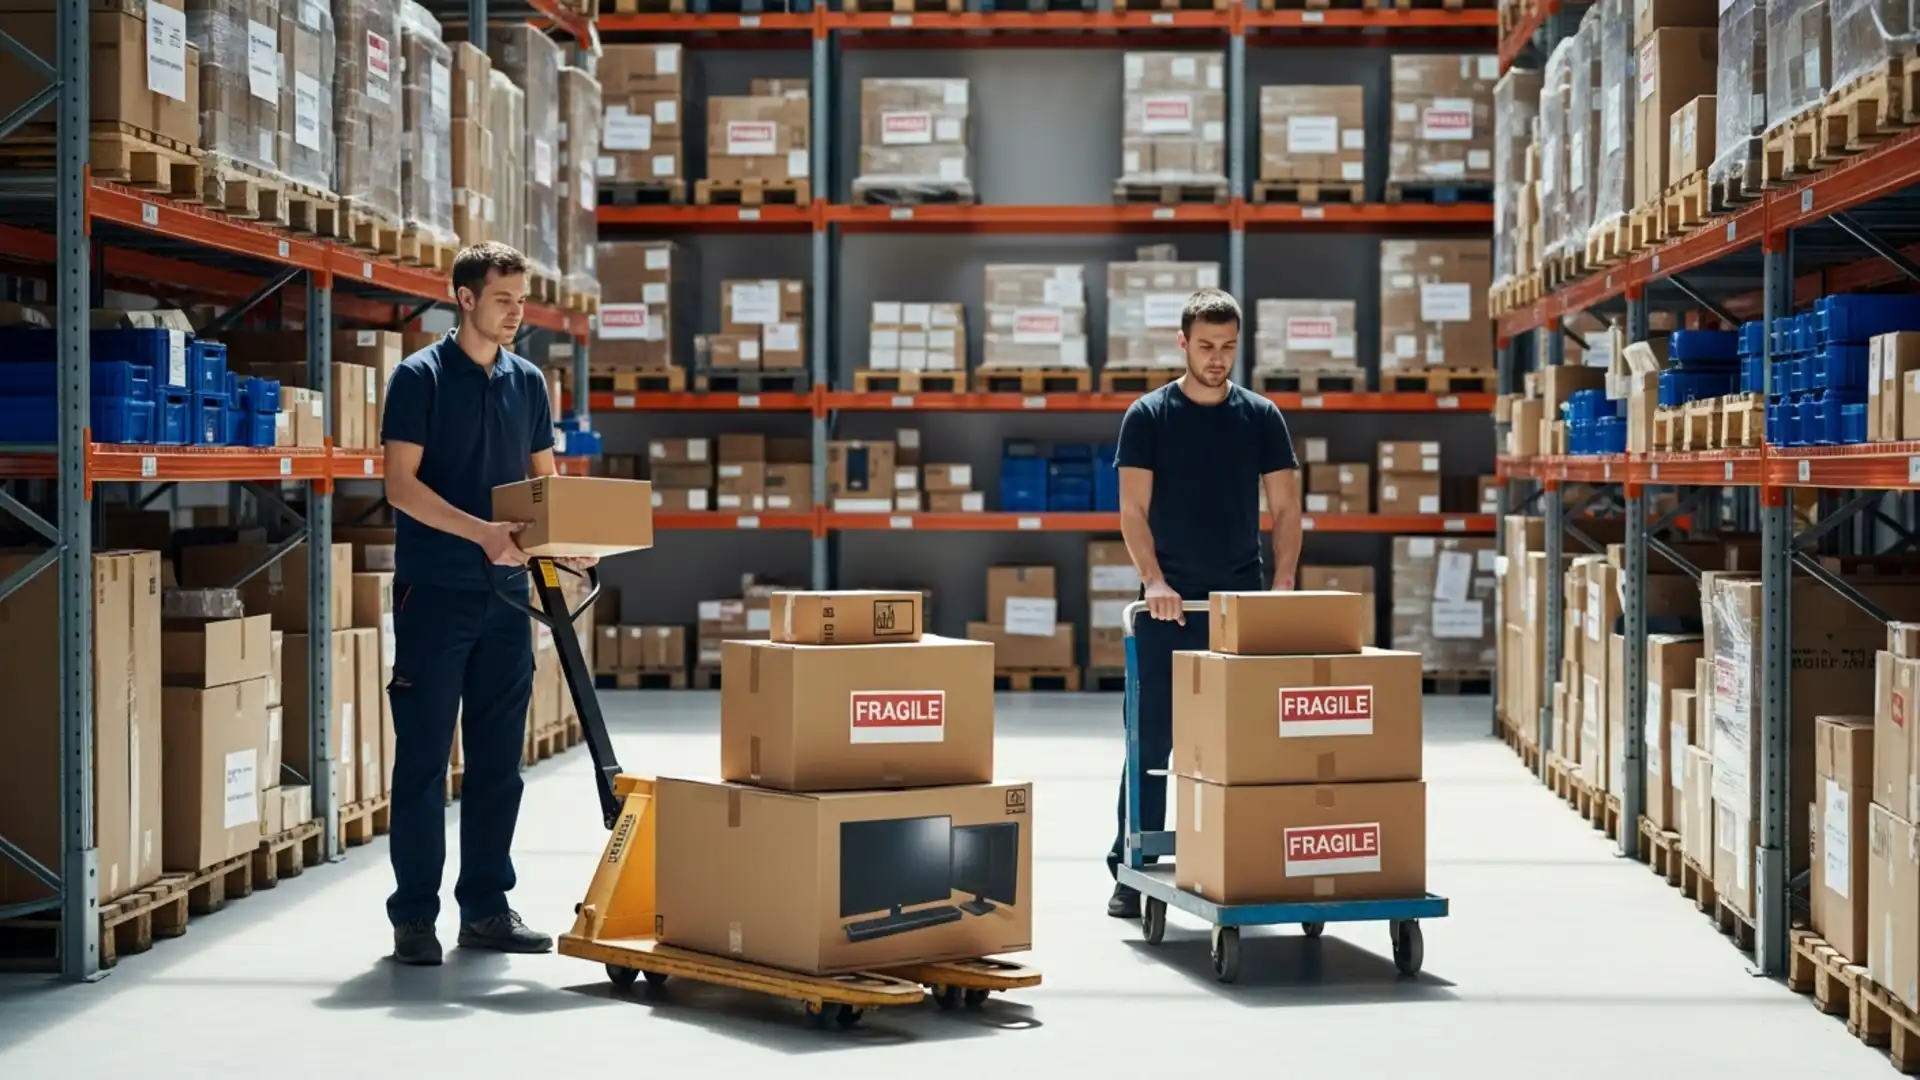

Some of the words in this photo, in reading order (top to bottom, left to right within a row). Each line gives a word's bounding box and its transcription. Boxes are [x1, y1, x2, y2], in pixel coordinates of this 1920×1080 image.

[856, 700, 940, 721] FRAGILE
[1284, 695, 1369, 716] FRAGILE
[1289, 832, 1376, 856] FRAGILE
